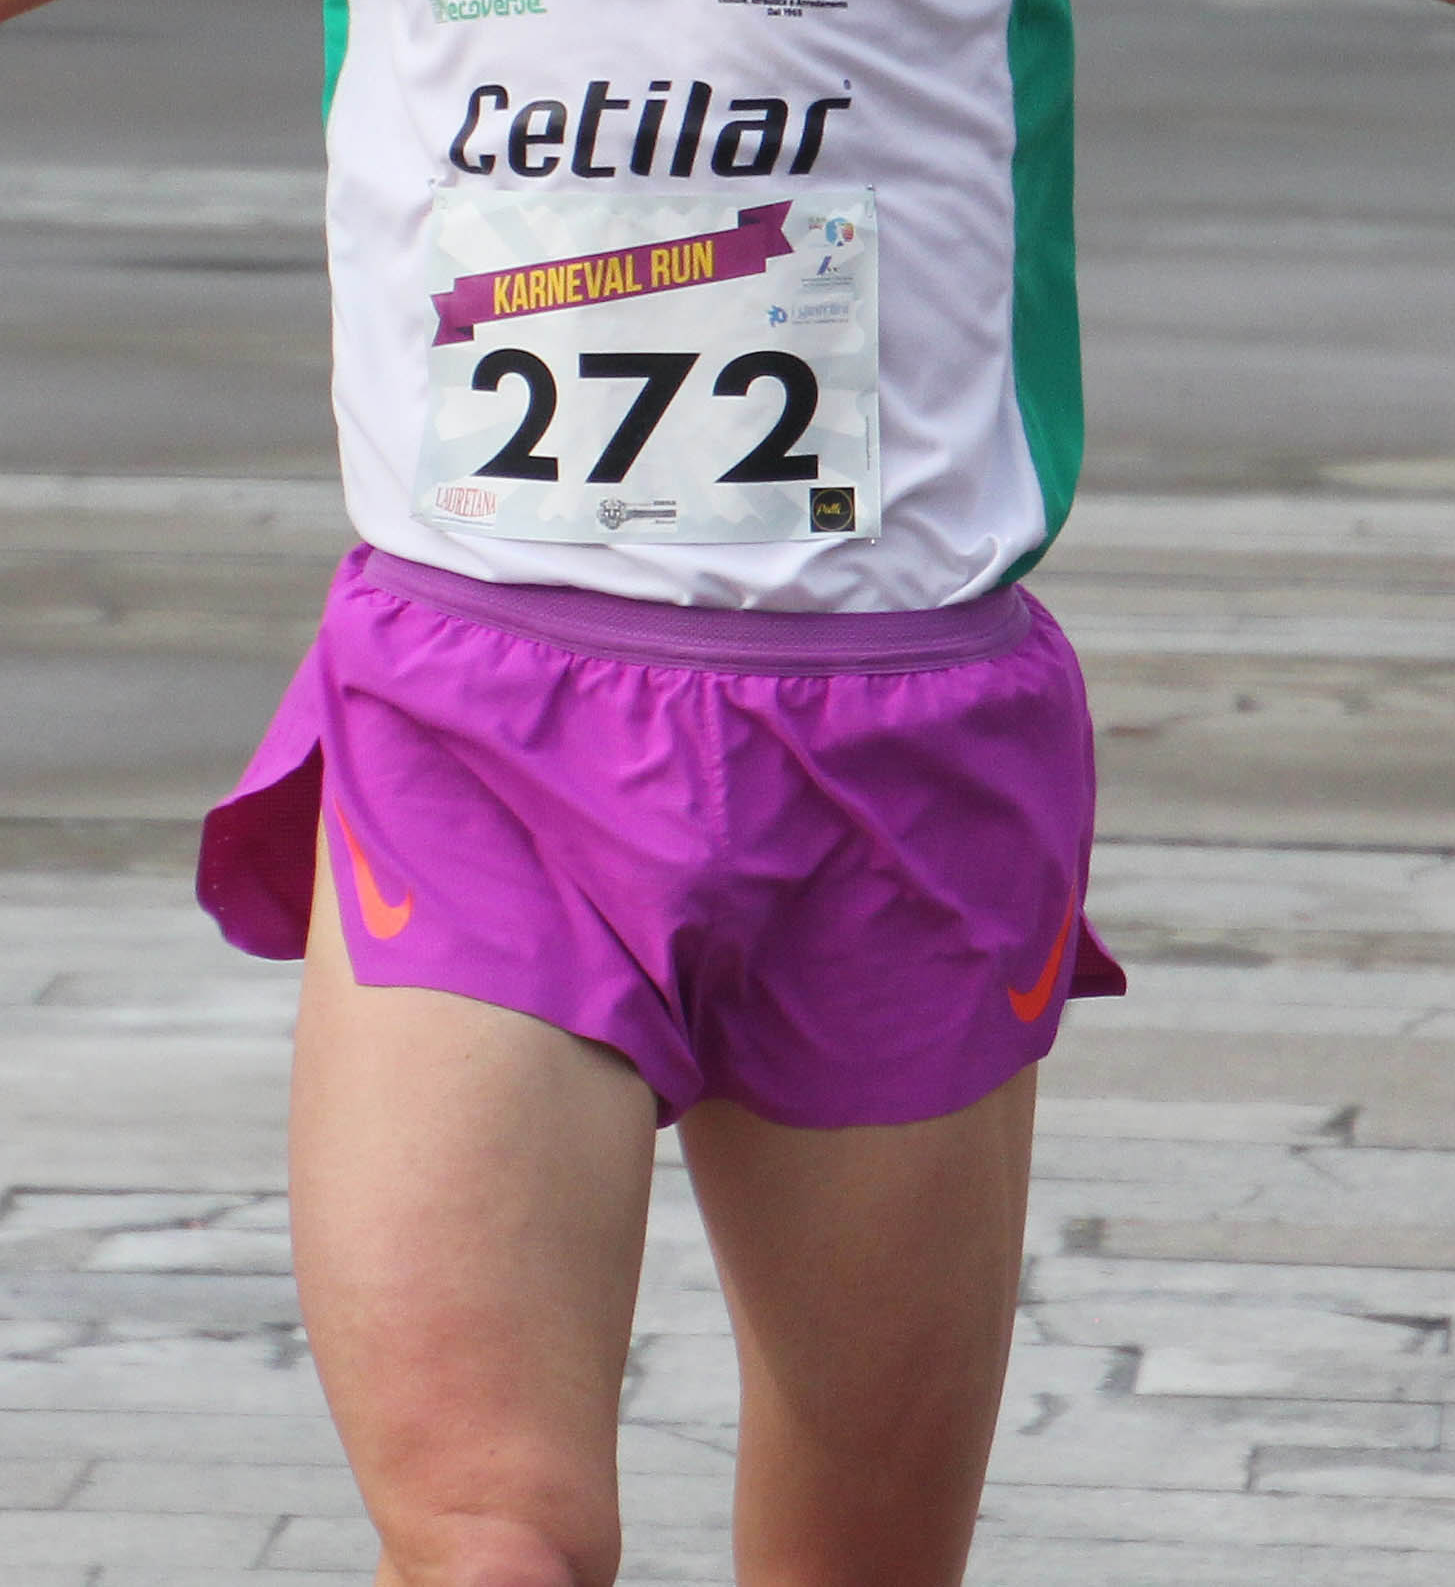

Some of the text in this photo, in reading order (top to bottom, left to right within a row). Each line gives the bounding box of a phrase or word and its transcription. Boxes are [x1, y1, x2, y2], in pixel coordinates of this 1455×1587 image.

[449, 79, 852, 178] Cetilar
[494, 240, 714, 316] KARNEVAL RUN
[471, 347, 819, 484] 272
